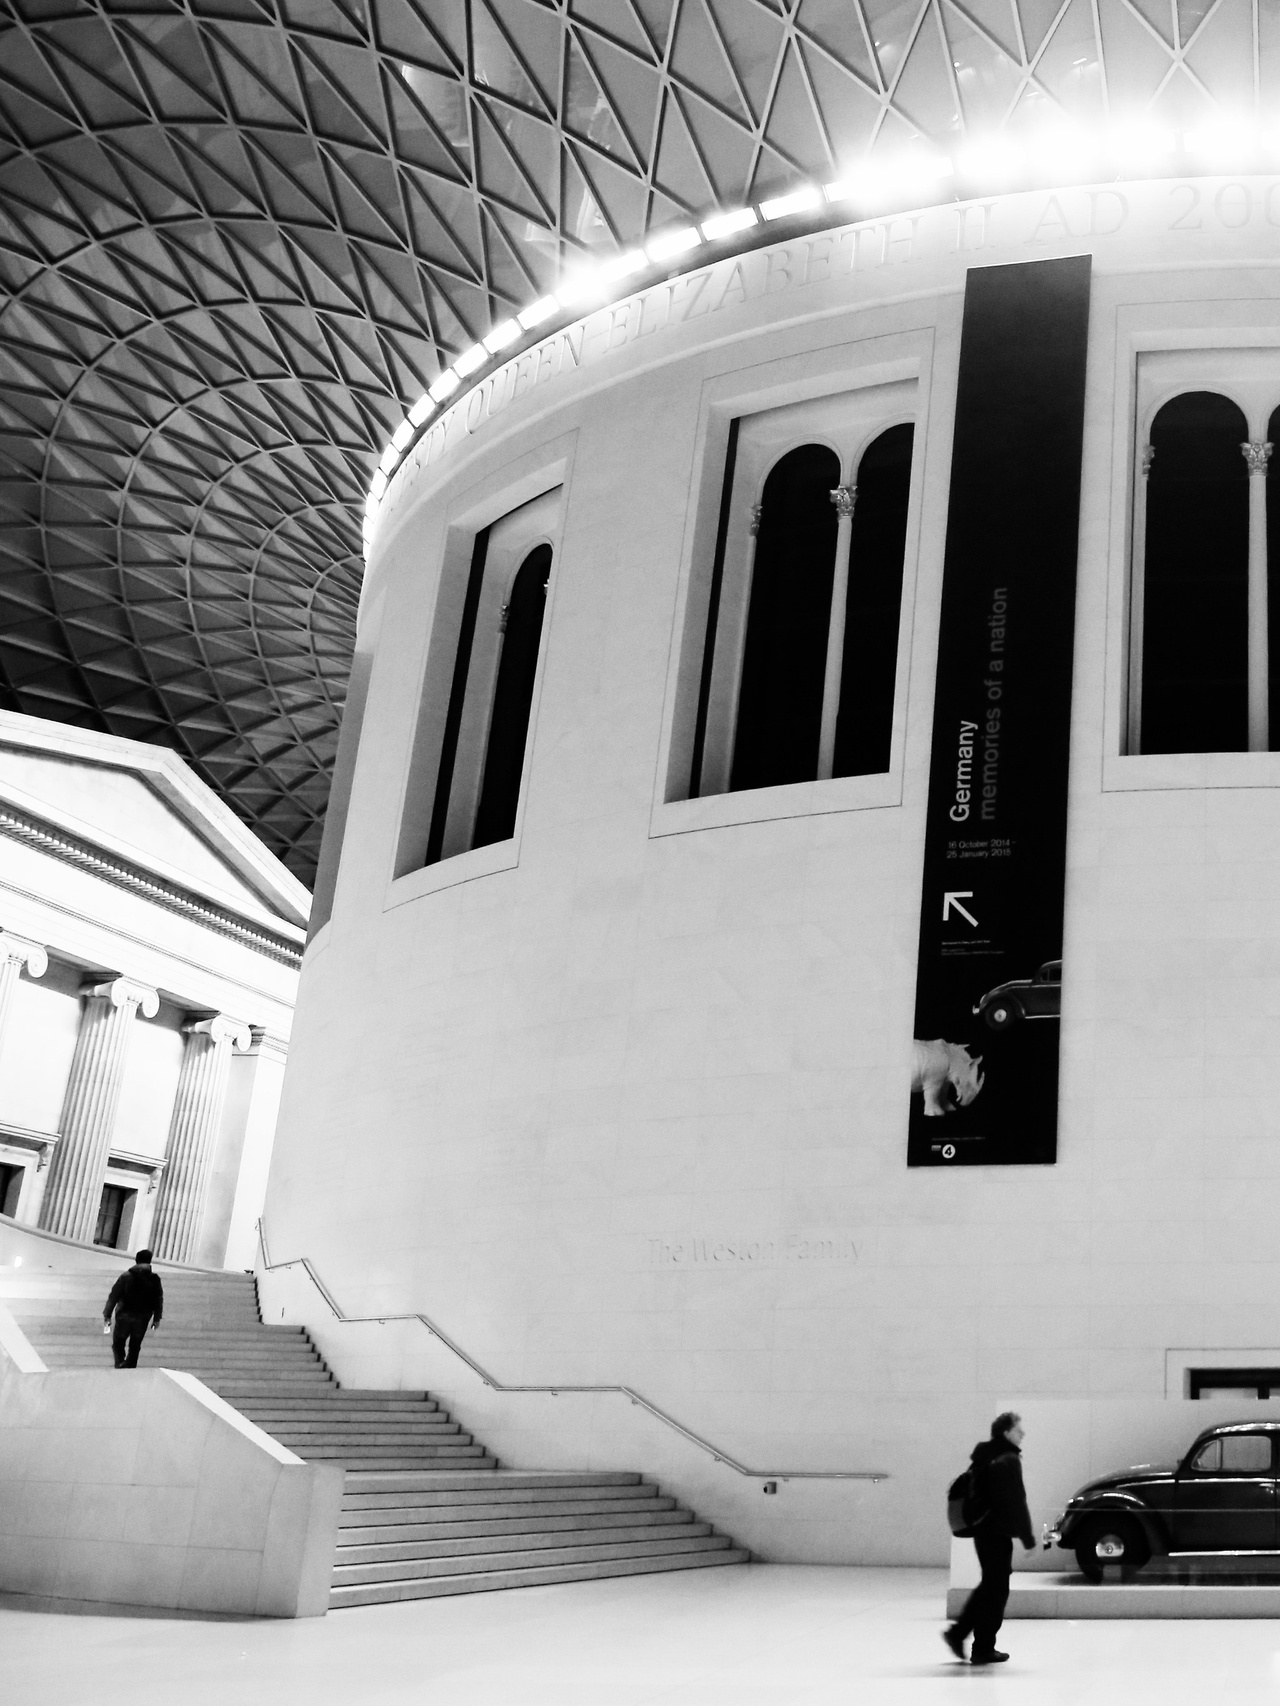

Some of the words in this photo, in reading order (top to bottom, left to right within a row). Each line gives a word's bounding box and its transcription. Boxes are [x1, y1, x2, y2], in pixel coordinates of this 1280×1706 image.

[464, 321, 590, 436] QUEEN
[601, 215, 925, 355] ELIZABETH
[954, 203, 996, 256] II
[1026, 187, 1133, 243] AD
[987, 587, 1008, 652] nation
[989, 659, 1004, 672] a
[984, 679, 1003, 699] of
[949, 720, 978, 822] Germany
[981, 707, 1001, 820] memories
[946, 850, 957, 859] 25
[958, 850, 989, 860] January
[991, 848, 1012, 857] 2015
[958, 840, 989, 849] October
[990, 838, 1010, 848] 2014
[648, 1237, 684, 1264] The
